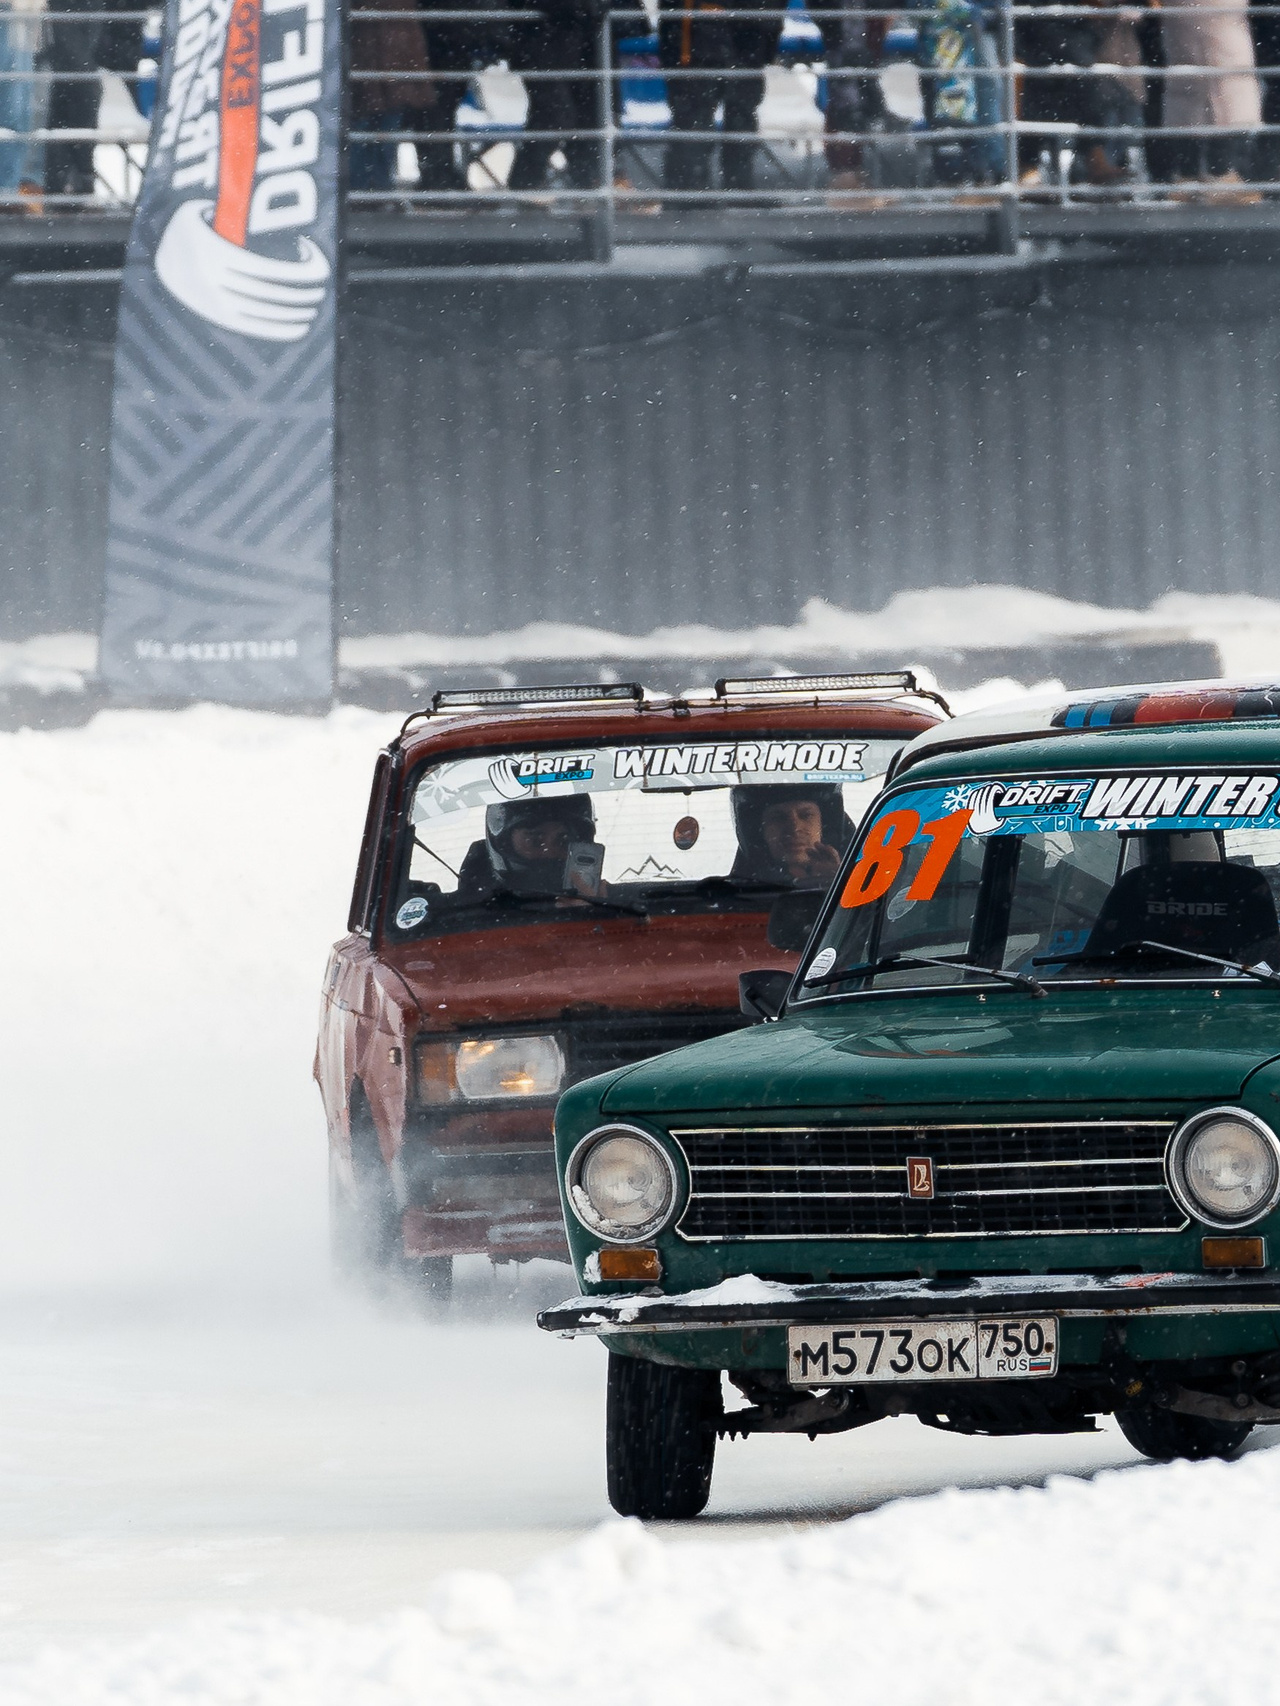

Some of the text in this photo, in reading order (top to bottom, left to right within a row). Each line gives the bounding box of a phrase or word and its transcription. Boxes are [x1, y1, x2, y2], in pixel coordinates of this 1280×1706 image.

[519, 755, 594, 776] DRIFT
[614, 742, 869, 779] WINTER MODE
[555, 771, 584, 780] EXPO
[999, 784, 1089, 807] DRIFT
[1034, 804, 1069, 814] EXPO
[840, 809, 975, 908] 81
[1147, 900, 1228, 916] BRIDE
[801, 1322, 1045, 1376] M573OK 750
[997, 1358, 1028, 1371] RUS
